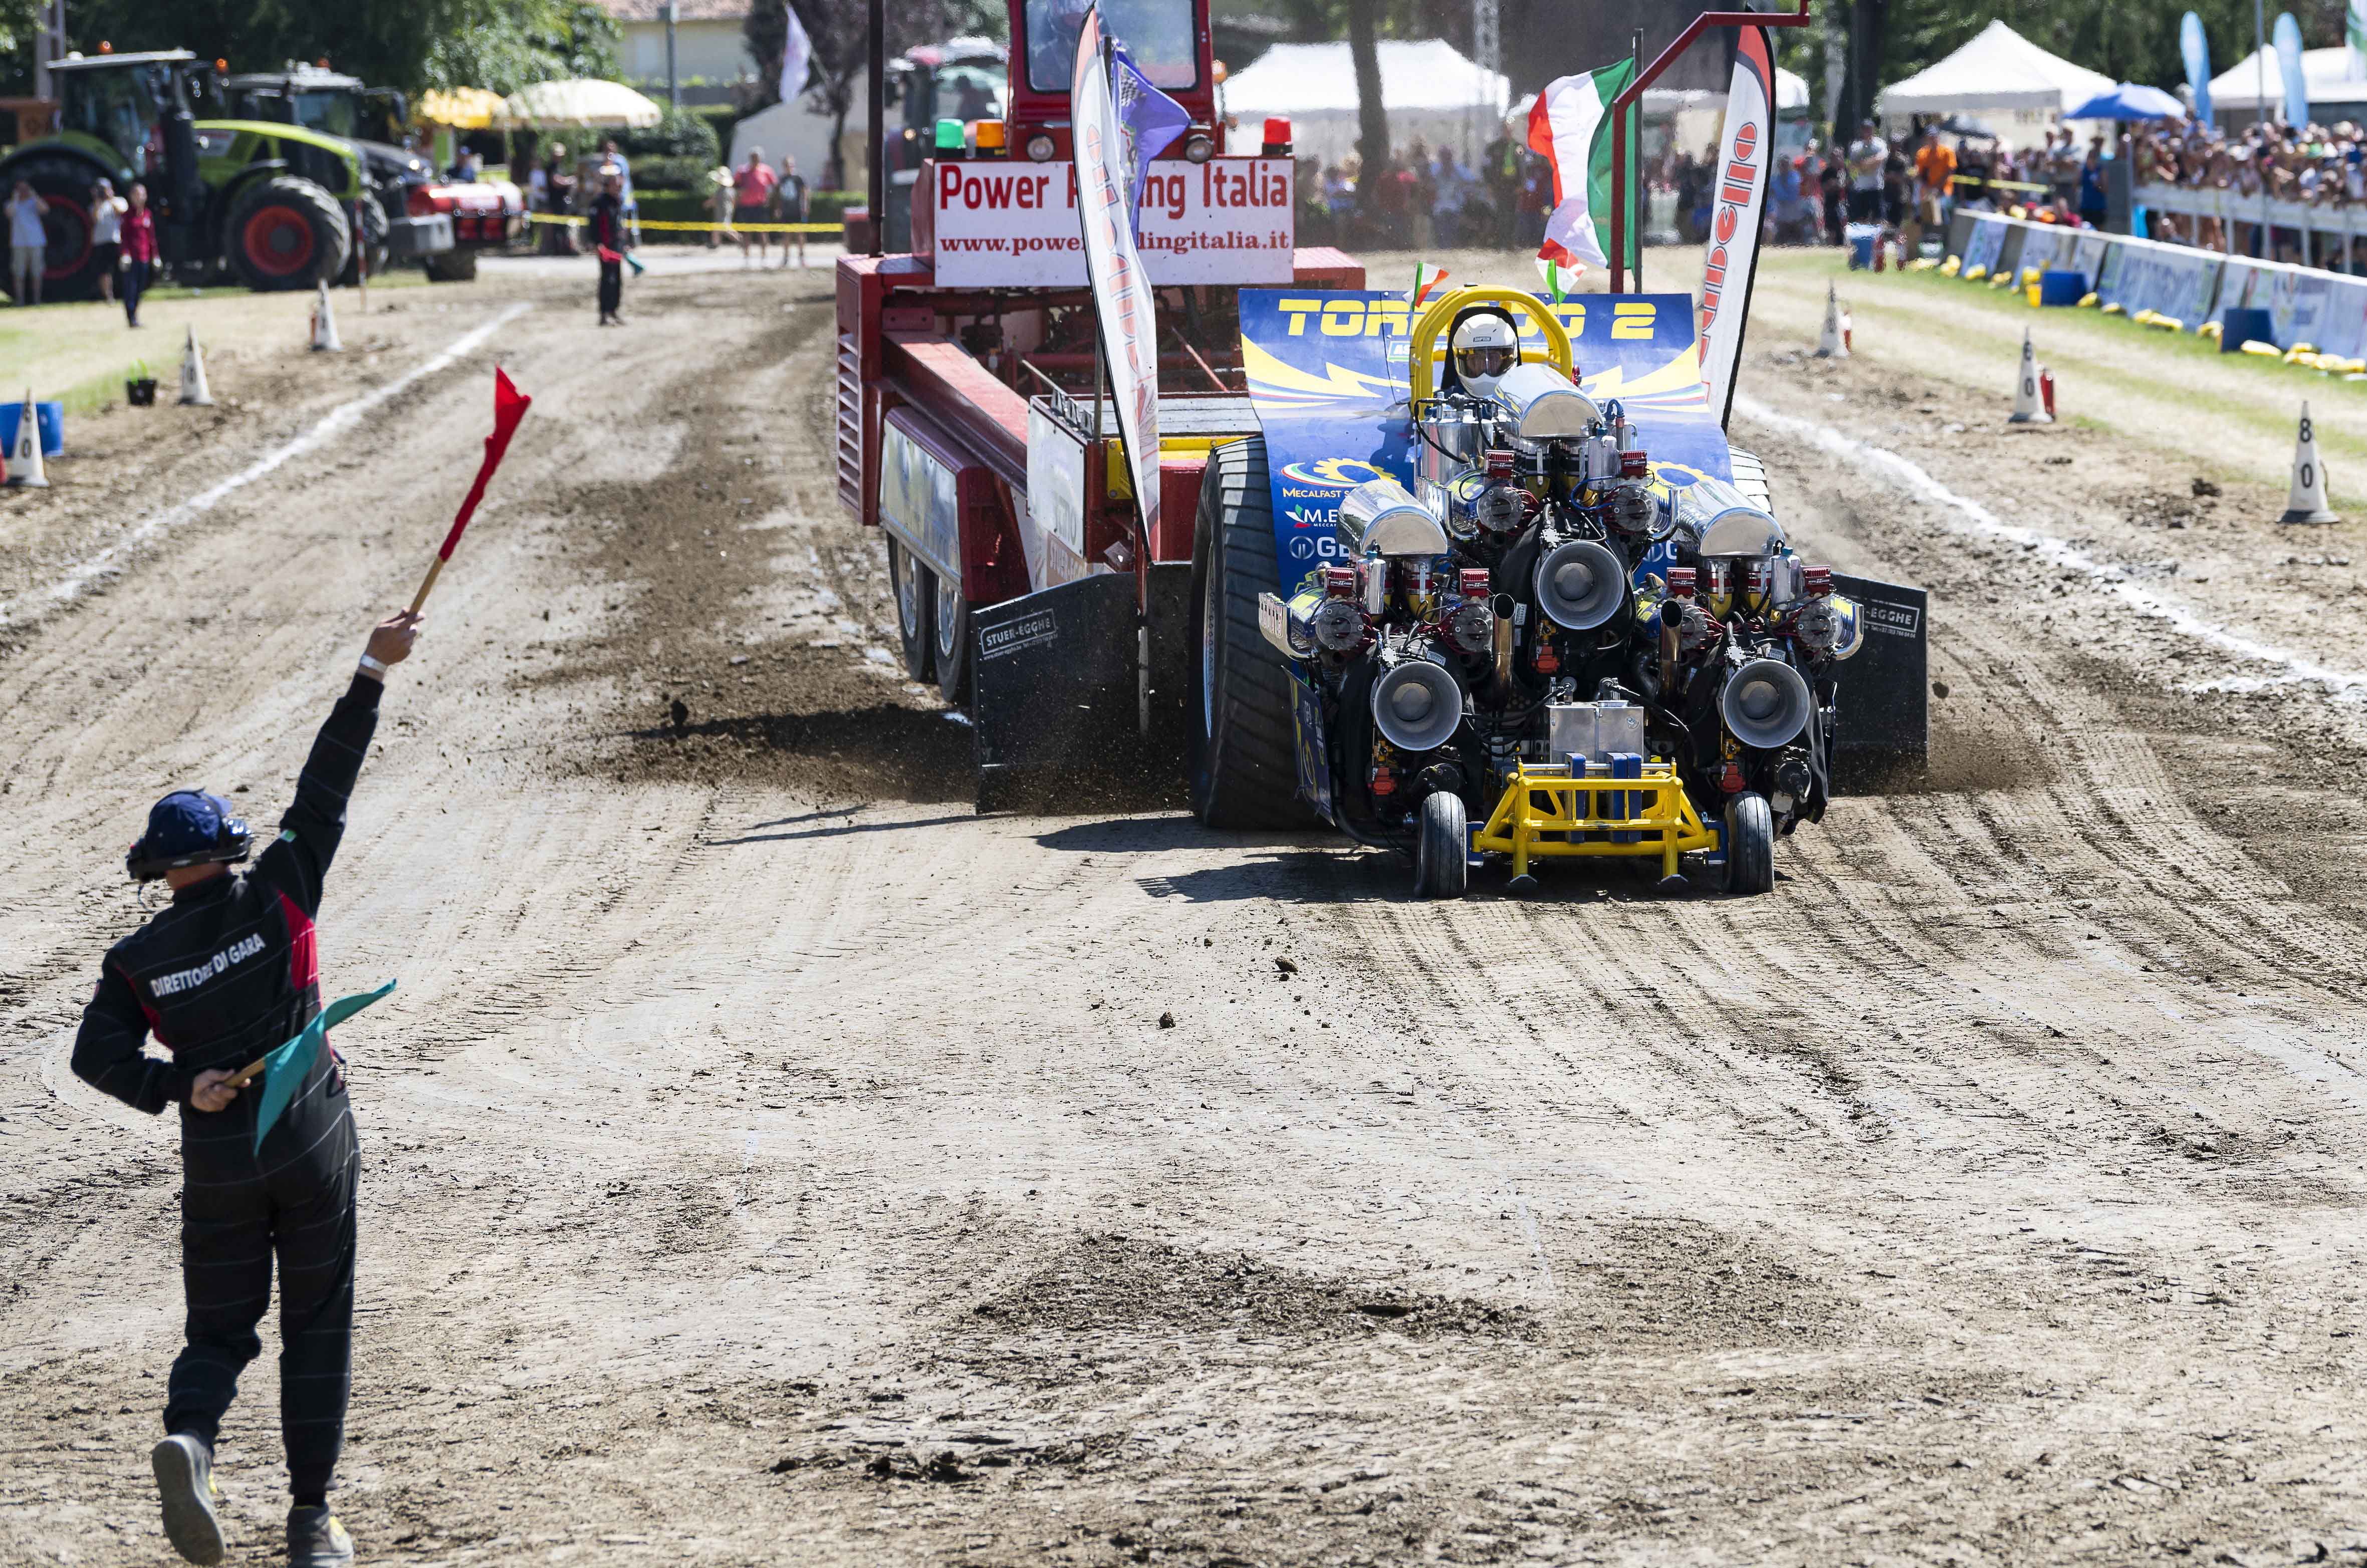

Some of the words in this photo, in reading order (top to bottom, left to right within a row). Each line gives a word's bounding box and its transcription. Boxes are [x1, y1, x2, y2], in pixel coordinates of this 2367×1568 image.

[939, 164, 1049, 210] Power
[1203, 160, 1288, 208] Italia
[939, 230, 1290, 256] www.powelingitalia.it
[1278, 299, 1586, 339] TORO
[1611, 303, 1656, 340] 2
[1282, 487, 1342, 497] MECALFAST
[1865, 607, 1912, 625] -EGGHE
[986, 618, 1051, 647] STUER-EGGHE
[212, 951, 229, 973] DI
[228, 933, 267, 963] GARA
